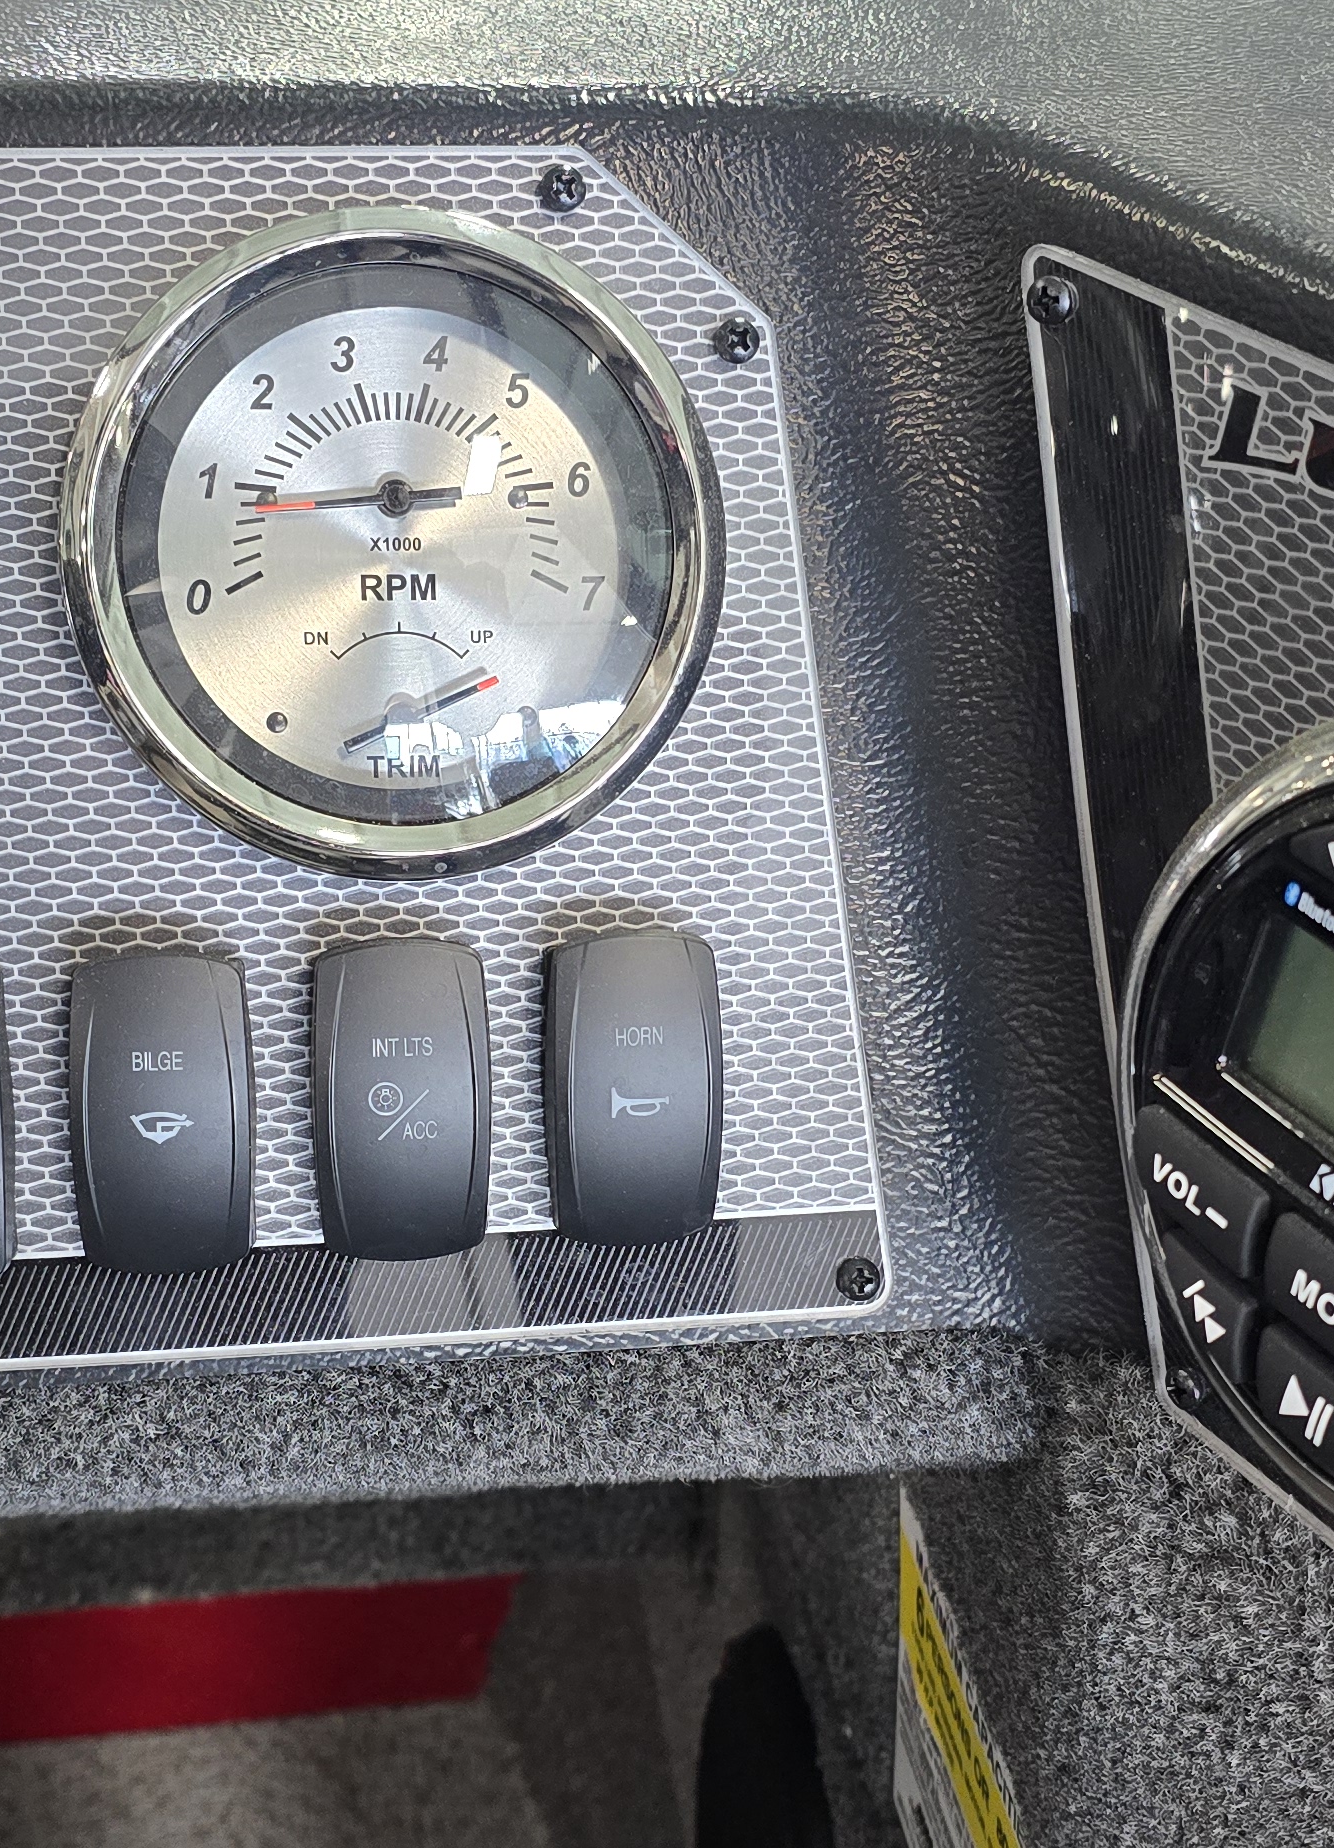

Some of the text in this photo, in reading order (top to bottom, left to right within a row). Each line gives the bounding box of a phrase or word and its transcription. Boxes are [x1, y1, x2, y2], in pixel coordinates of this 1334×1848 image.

[331, 337, 356, 371] 3
[423, 336, 448, 371] 4
[250, 375, 274, 410] 2
[505, 373, 531, 408] 5
[198, 463, 221, 498] 1
[567, 461, 591, 497] 6
[369, 537, 422, 552] X1000
[186, 579, 211, 614] 0
[360, 574, 437, 601] RPM
[581, 576, 604, 610] 7
[304, 631, 329, 646] DN
[471, 630, 493, 644] UP
[366, 755, 441, 779] TRIM
[371, 1037, 433, 1057] INT LTS
[615, 1027, 664, 1047] HORN
[131, 1051, 184, 1071] BILGE
[403, 1120, 437, 1140] ACC
